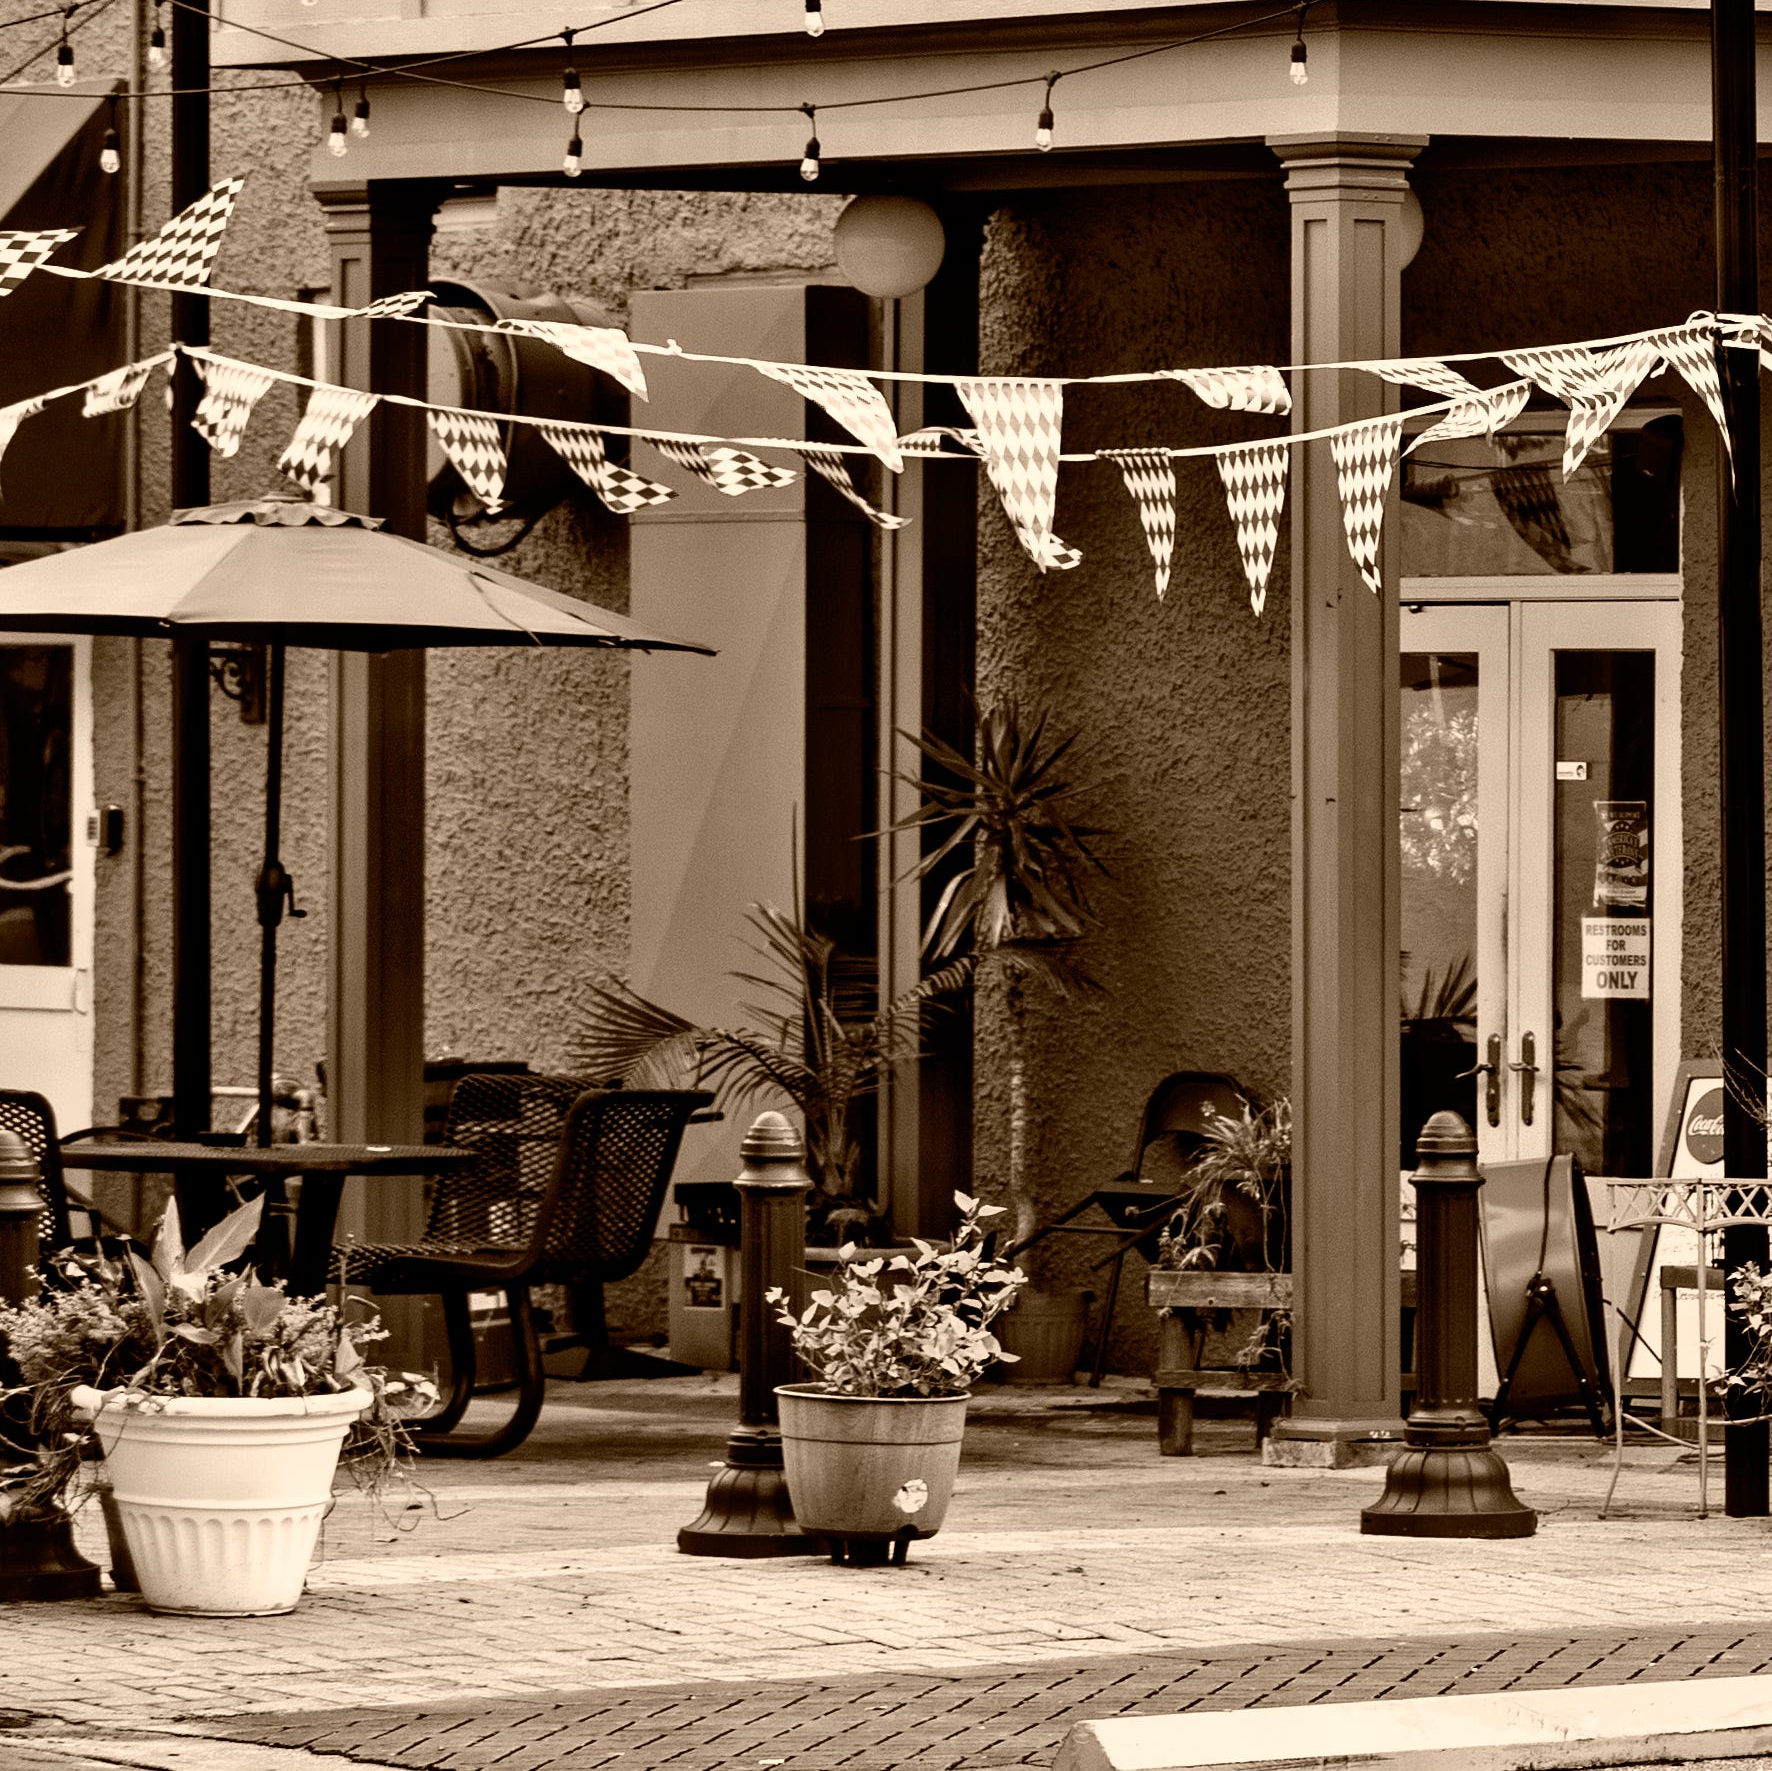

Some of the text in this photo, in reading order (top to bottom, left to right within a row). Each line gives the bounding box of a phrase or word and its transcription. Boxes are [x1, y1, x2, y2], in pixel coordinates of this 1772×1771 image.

[1585, 924, 1647, 937] RESTROOMS
[1606, 939, 1626, 951] FOR
[1585, 954, 1647, 967] CUSTOMERS
[1596, 971, 1639, 990] ONLY
